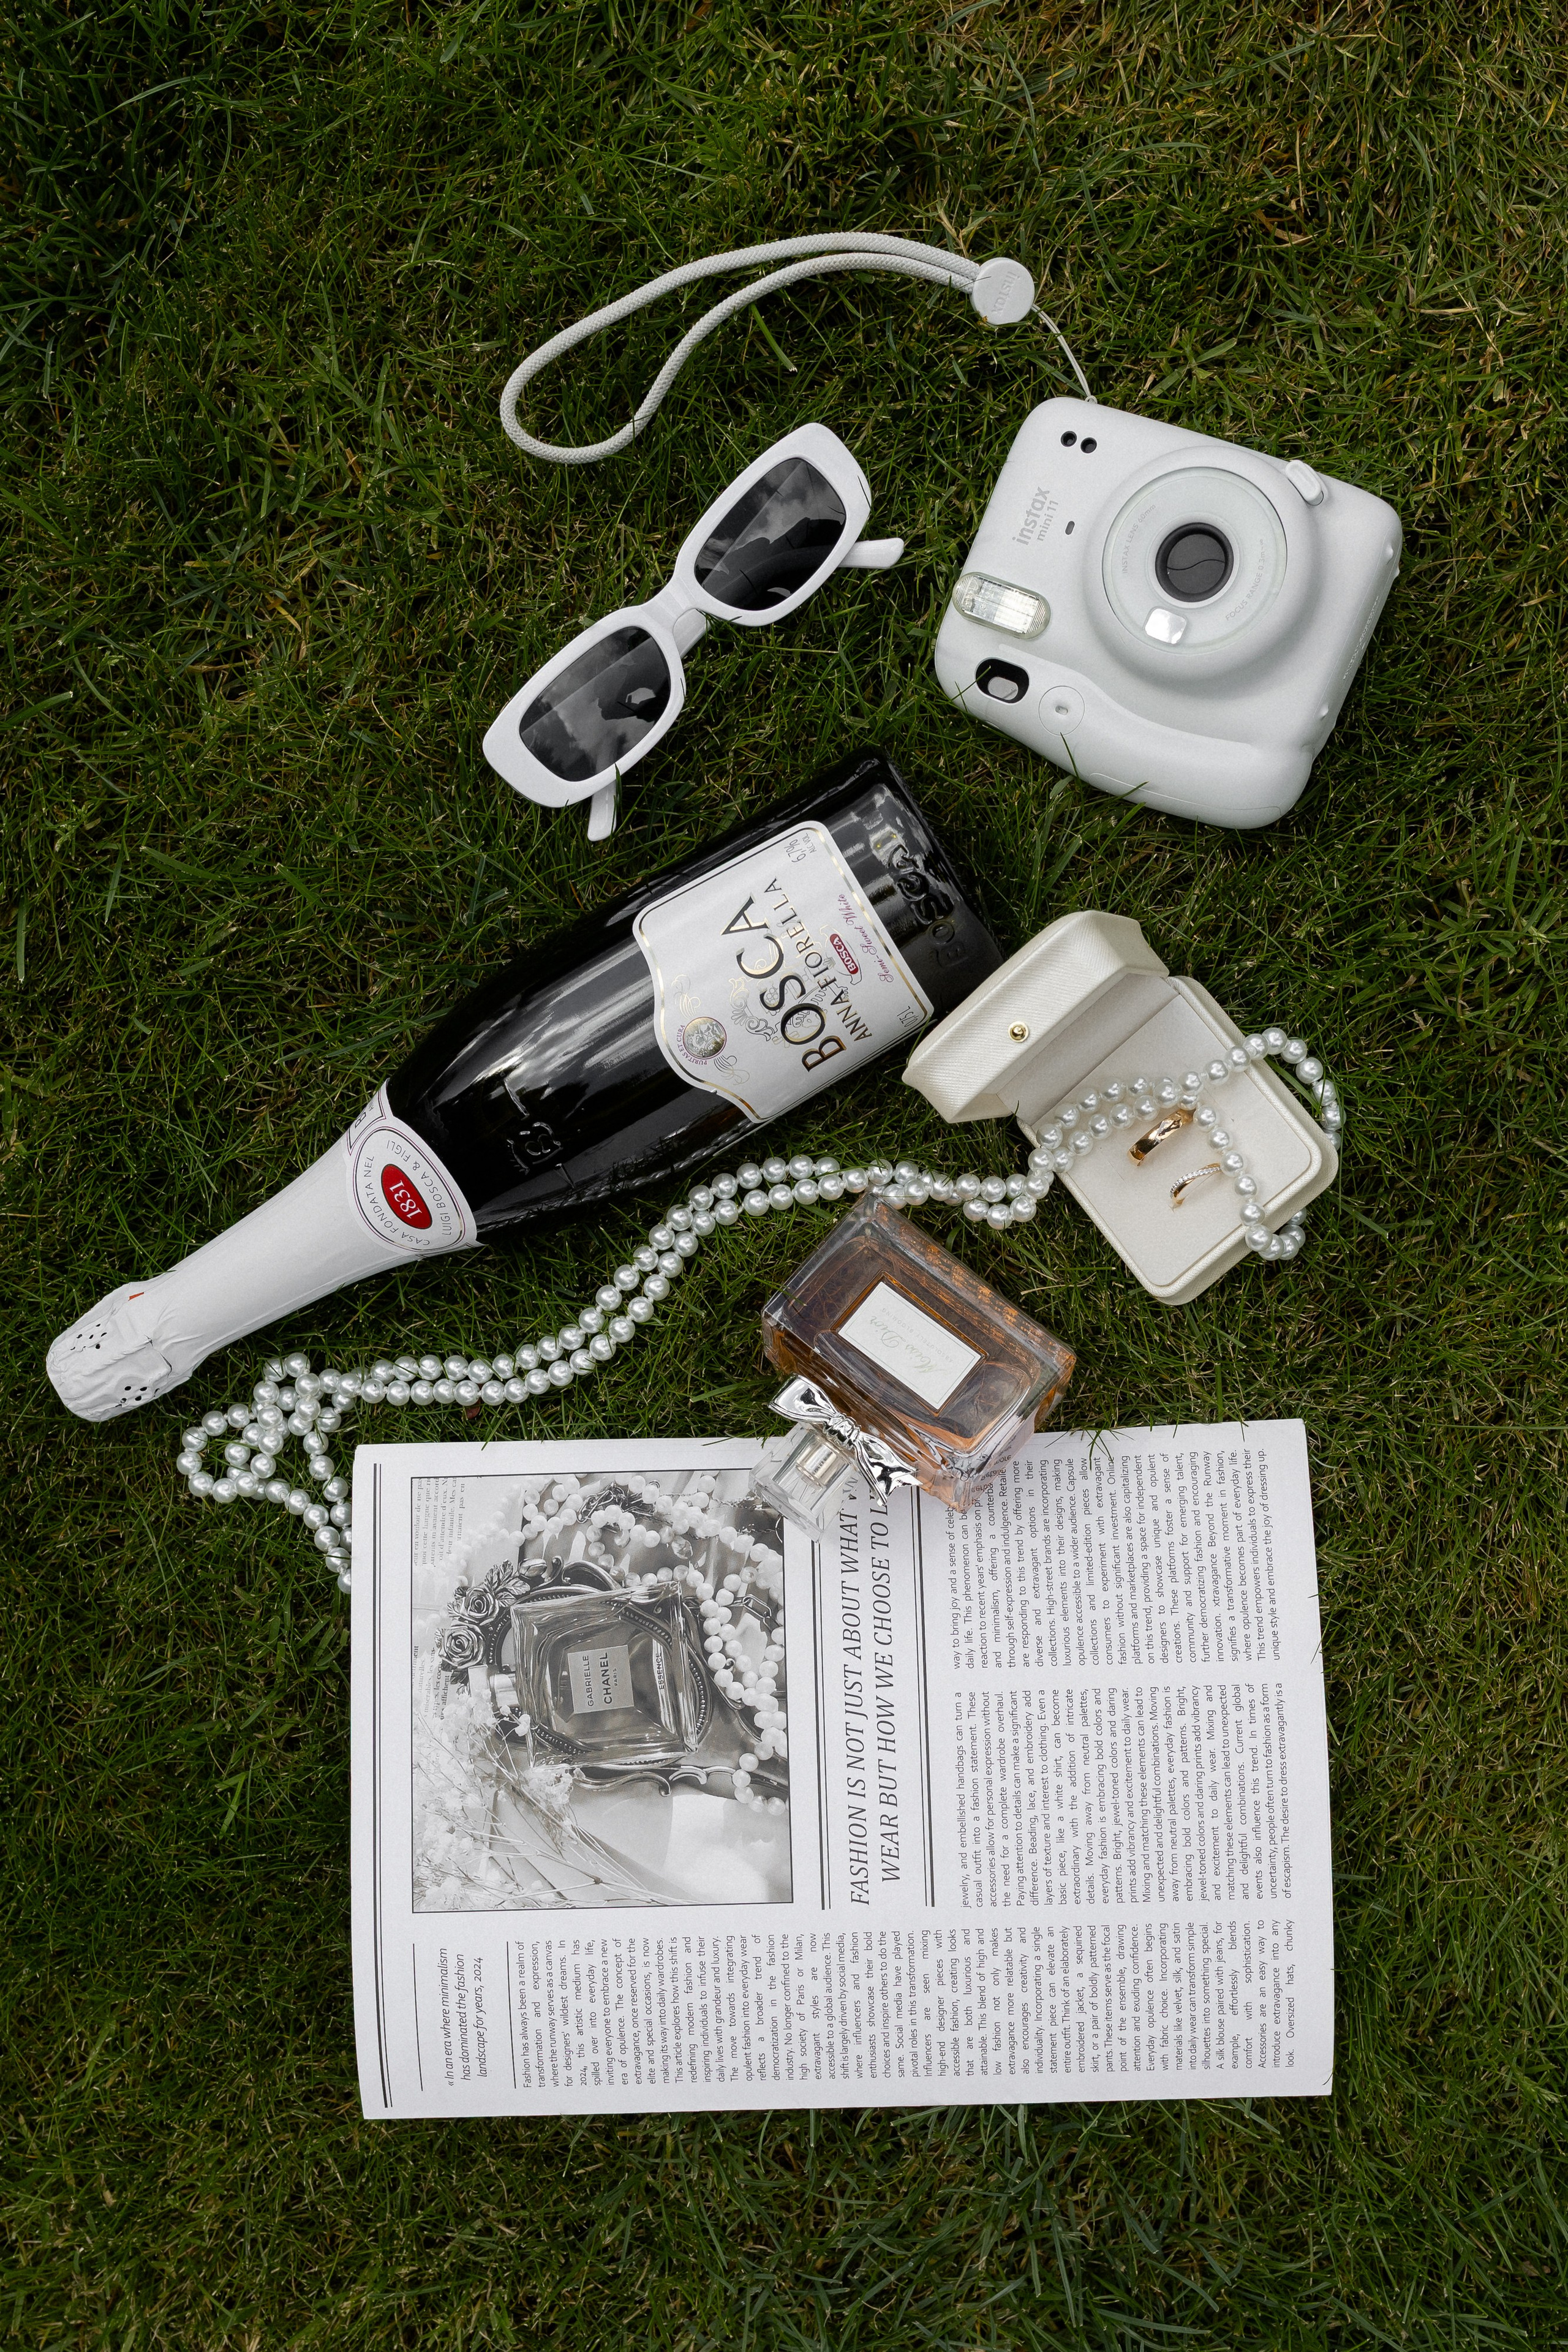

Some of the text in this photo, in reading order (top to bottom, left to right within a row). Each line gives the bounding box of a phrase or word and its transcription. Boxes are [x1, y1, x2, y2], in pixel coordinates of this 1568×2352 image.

[1012, 486, 1050, 545] instax
[1037, 500, 1058, 541] mini 11
[1128, 524, 1138, 543] LENS
[1138, 504, 1156, 522] 60mm
[1226, 600, 1247, 620] FOCUS
[1246, 573, 1262, 599] RANGE
[783, 839, 807, 862] 6,7%
[802, 832, 810, 845] VOL
[833, 937, 856, 972] BOSCA
[838, 894, 894, 982] Semi-Sweet White
[764, 878, 872, 1042] ANNA FIORELLA
[720, 892, 847, 1072] BOSCA
[682, 1052, 707, 1065] PURITAS
[364, 1156, 375, 1177] NEL
[387, 1139, 451, 1235] LUIGI BOSCA & FIGLI
[390, 1180, 423, 1219] 1831
[364, 1182, 399, 1233] FONDATA
[401, 1232, 430, 1245] CASA
[870, 1316, 944, 1374] Miss Dior
[881, 1308, 953, 1363] ABSOLUTELY BLOOMING
[1024, 1460, 1034, 1480] their
[870, 1521, 889, 1550] TO
[1028, 1507, 1039, 1538] options
[839, 1510, 859, 1574] WHAT
[1203, 1451, 1224, 1662] innovation. xtravagance Beyond the Runway
[1258, 1449, 1281, 1660] unique style and embrace the joy of dressing up.
[1030, 1548, 1041, 1599] extravagant
[872, 1556, 892, 1646] CHOOSE
[1032, 1609, 1041, 1626] and
[841, 1580, 862, 1660] ABOUT
[1035, 1635, 1044, 1667] diverse
[582, 1655, 594, 1706] GABRIELLE
[599, 1653, 612, 1704] CHANEL
[655, 1653, 664, 1689] ESSENCE
[875, 1652, 894, 1689] WE
[843, 1663, 868, 1719] JUST
[967, 1692, 976, 1719] These
[876, 1695, 896, 1754] HOW
[1274, 1698, 1287, 1760] extravagantly
[845, 1725, 867, 1771] NOT
[969, 1724, 978, 1773] statement.
[847, 1777, 866, 1798] IS
[878, 1758, 898, 1807] BUT
[1278, 1762, 1287, 1785] dress
[1280, 1787, 1288, 1796] to
[970, 1778, 979, 1811] fashion
[1079, 1689, 1095, 1904] details. Moving away from neutral palettes,
[1280, 1798, 1289, 1824] desire
[880, 1814, 901, 1882] WEAR
[972, 1826, 981, 1844] into
[1280, 1826, 1289, 1844] The
[848, 1804, 870, 1905] FASHION
[972, 1850, 982, 1874] outfit
[1281, 1845, 1293, 1888] escapism.
[973, 1880, 983, 1907] casual
[1281, 1889, 1291, 1899] of
[514, 1940, 524, 1950] of
[766, 1934, 775, 1966] fashion
[437, 1948, 450, 2007] minimalism
[516, 1953, 525, 1978] realm
[559, 1955, 567, 1990] dreams.
[767, 1976, 777, 1990] the
[518, 1988, 527, 2010] been
[559, 1996, 568, 2026] wildest
[1284, 1919, 1296, 2067] look. Oversized hats, chunky
[440, 2008, 451, 2038] where
[454, 1954, 471, 2081] has dominated the fashion
[473, 1957, 488, 2077] landscape for years, 2024
[519, 2011, 529, 2040] always
[530, 1941, 546, 2087] transformation and expression,
[444, 2041, 453, 2056] era
[445, 2057, 453, 2069] an
[521, 2042, 529, 2056] has
[561, 2032, 573, 2071] designers'
[769, 2016, 780, 2081] democratization
[522, 2059, 532, 2087] Fashion
[564, 2075, 573, 2087] for
